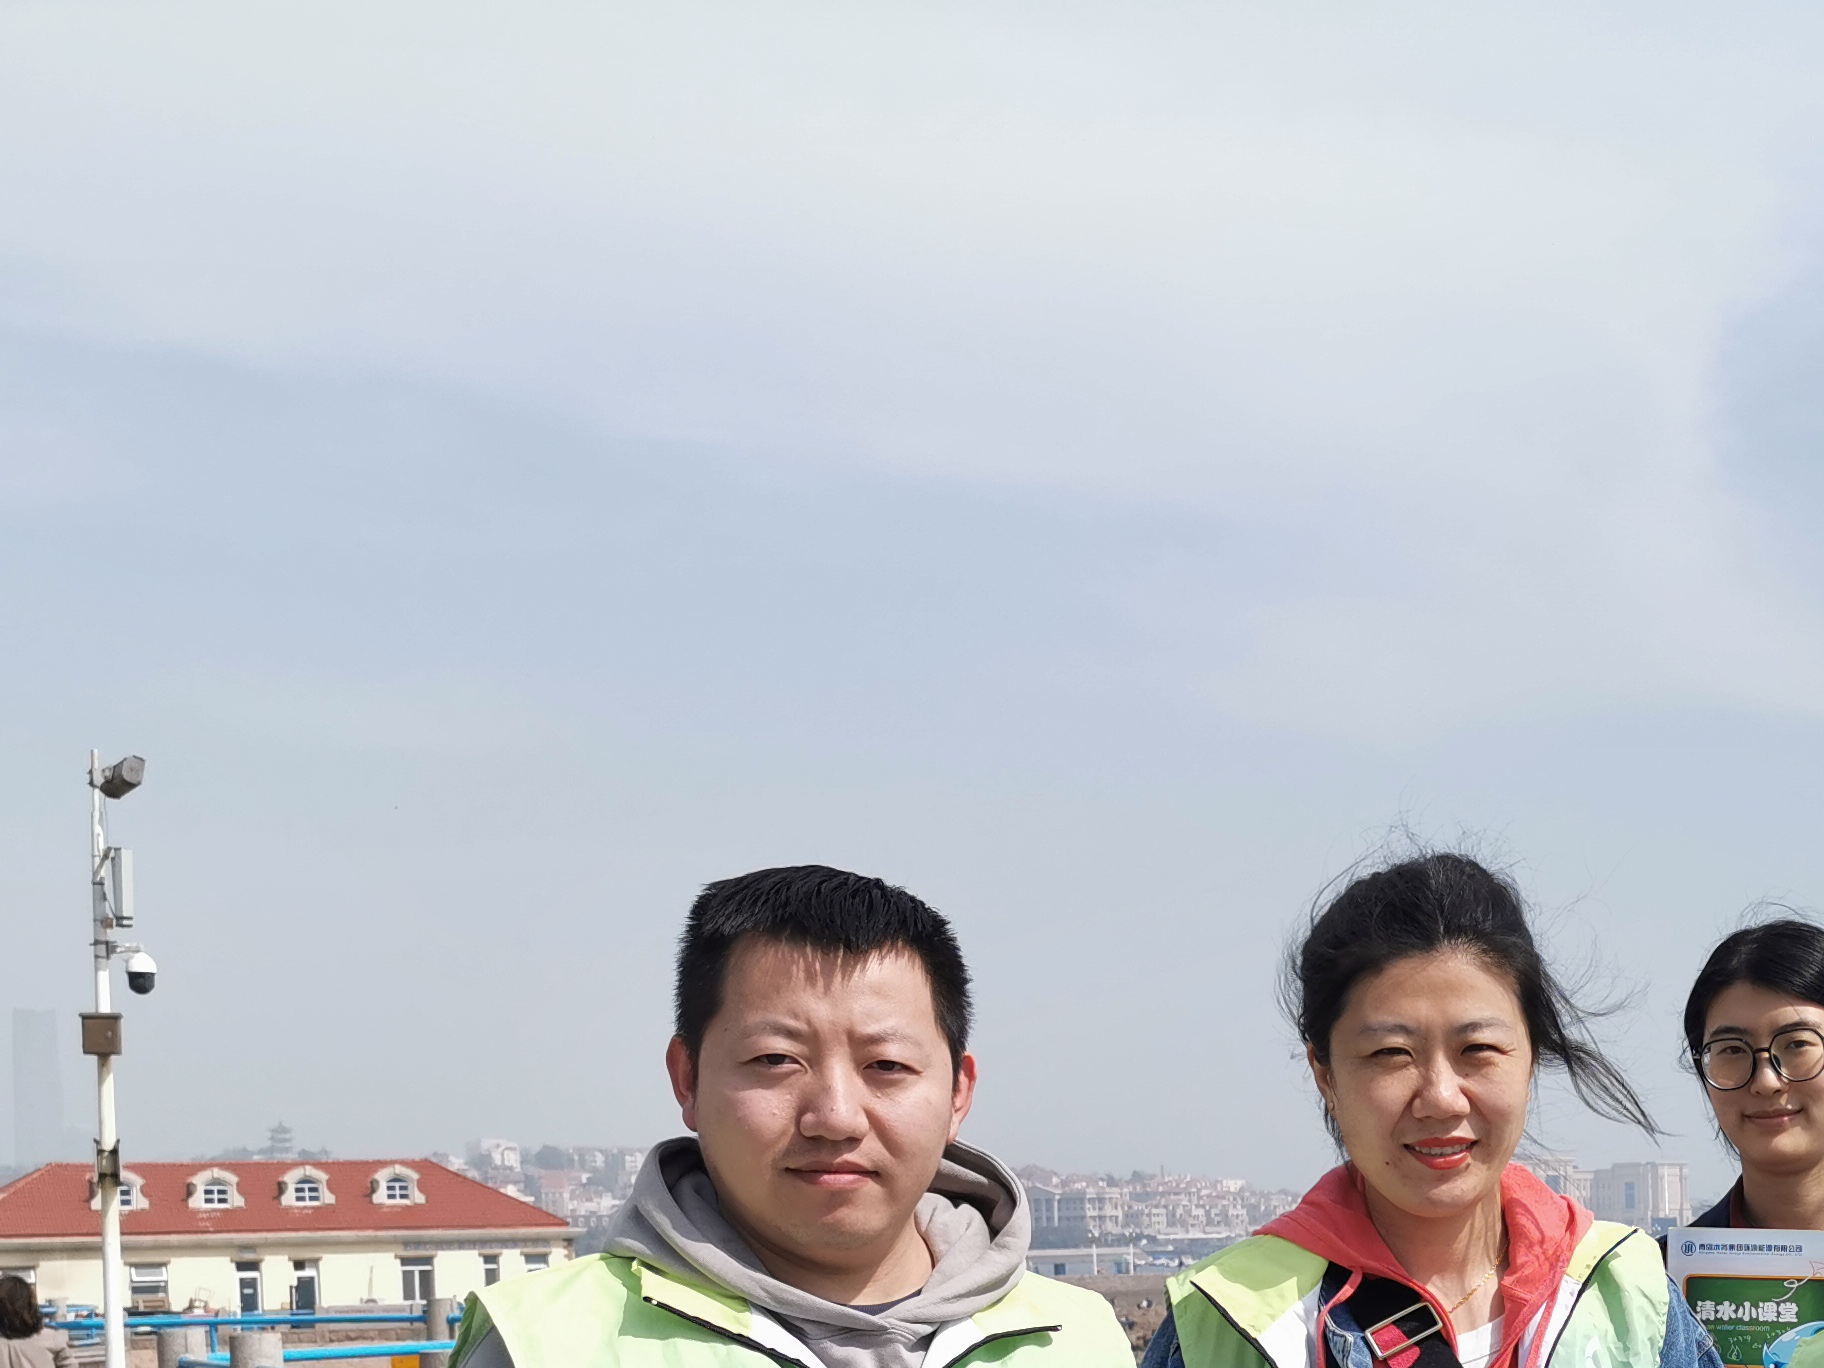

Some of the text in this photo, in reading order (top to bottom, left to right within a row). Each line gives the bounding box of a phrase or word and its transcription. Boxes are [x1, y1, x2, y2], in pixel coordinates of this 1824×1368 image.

[1696, 1300, 1799, 1323] 清水小课堂
[1735, 1324, 1770, 1332] classroom
